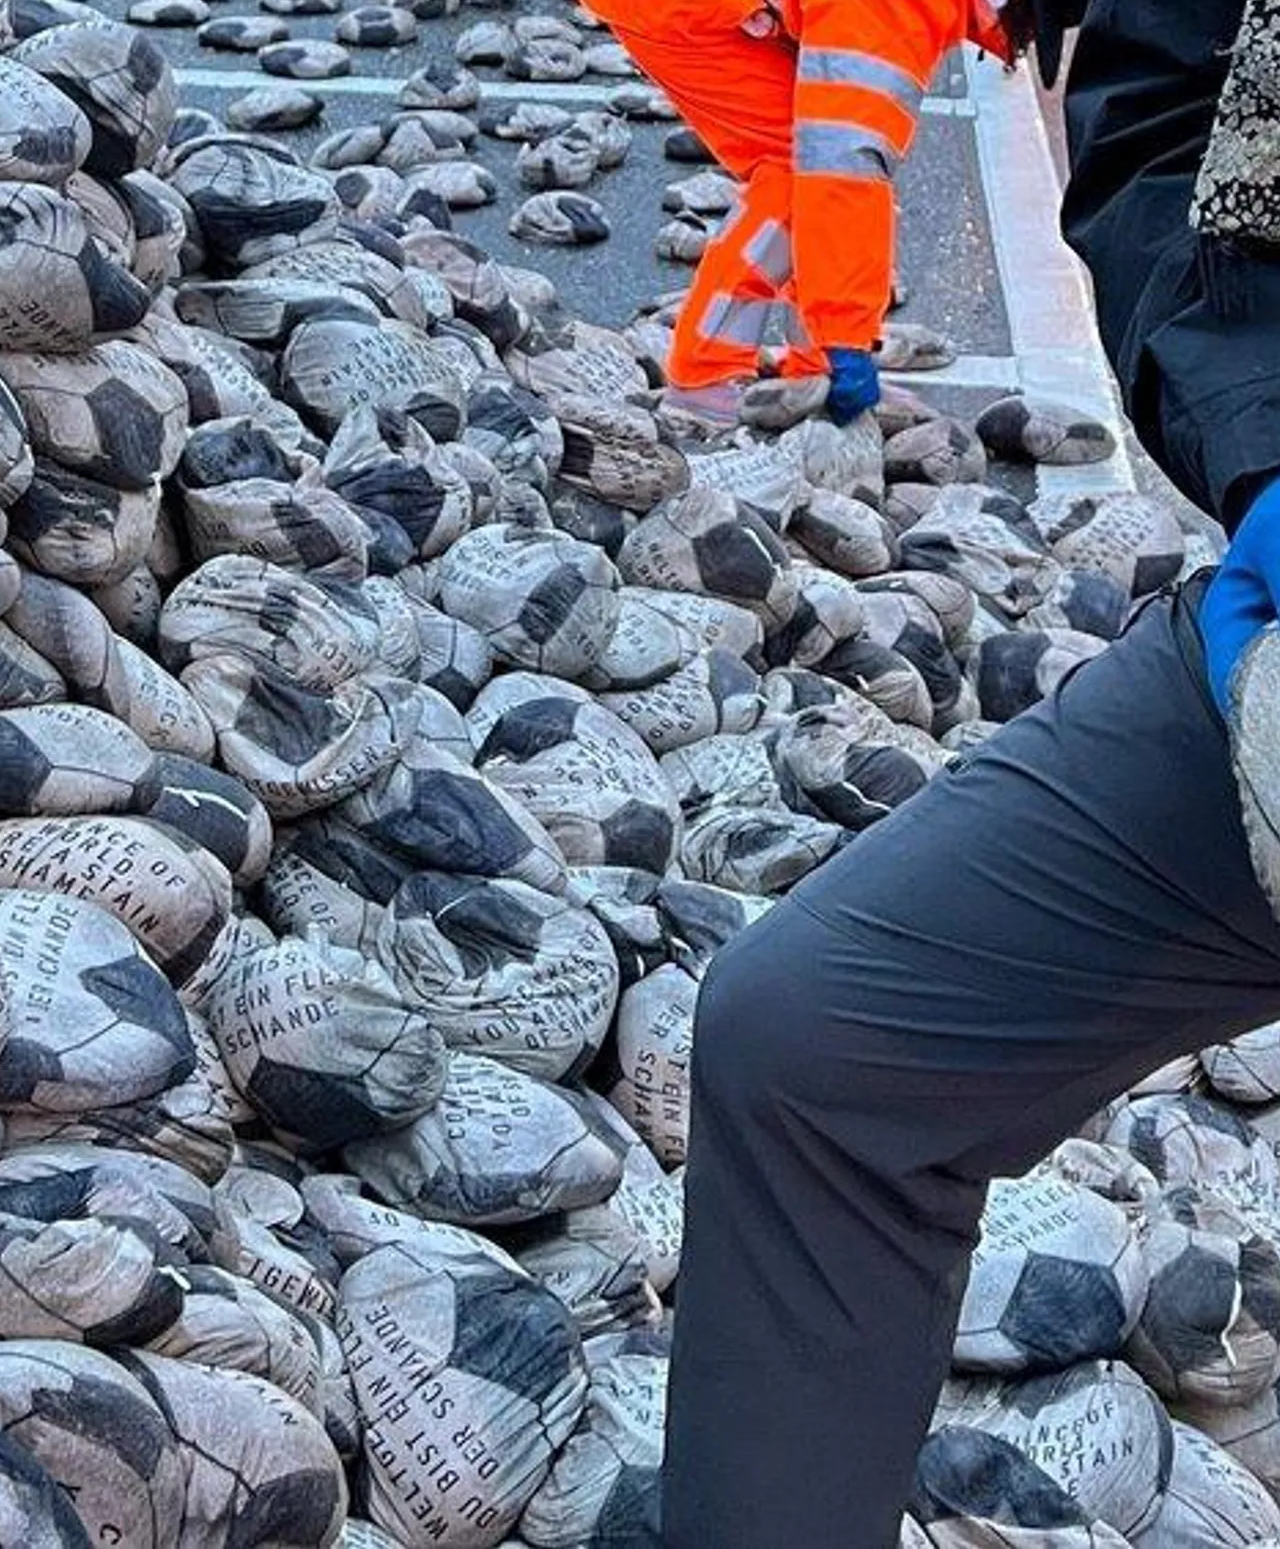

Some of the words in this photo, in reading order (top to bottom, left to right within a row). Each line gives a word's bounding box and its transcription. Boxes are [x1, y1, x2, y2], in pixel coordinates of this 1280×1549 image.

[86, 860, 165, 935] STAIN
[149, 860, 187, 888] OF
[224, 996, 342, 1055] SCHANDE
[367, 1374, 410, 1426] EIN
[404, 1430, 462, 1496] BIST
[451, 1424, 500, 1482] DER
[457, 1494, 498, 1530] DU
